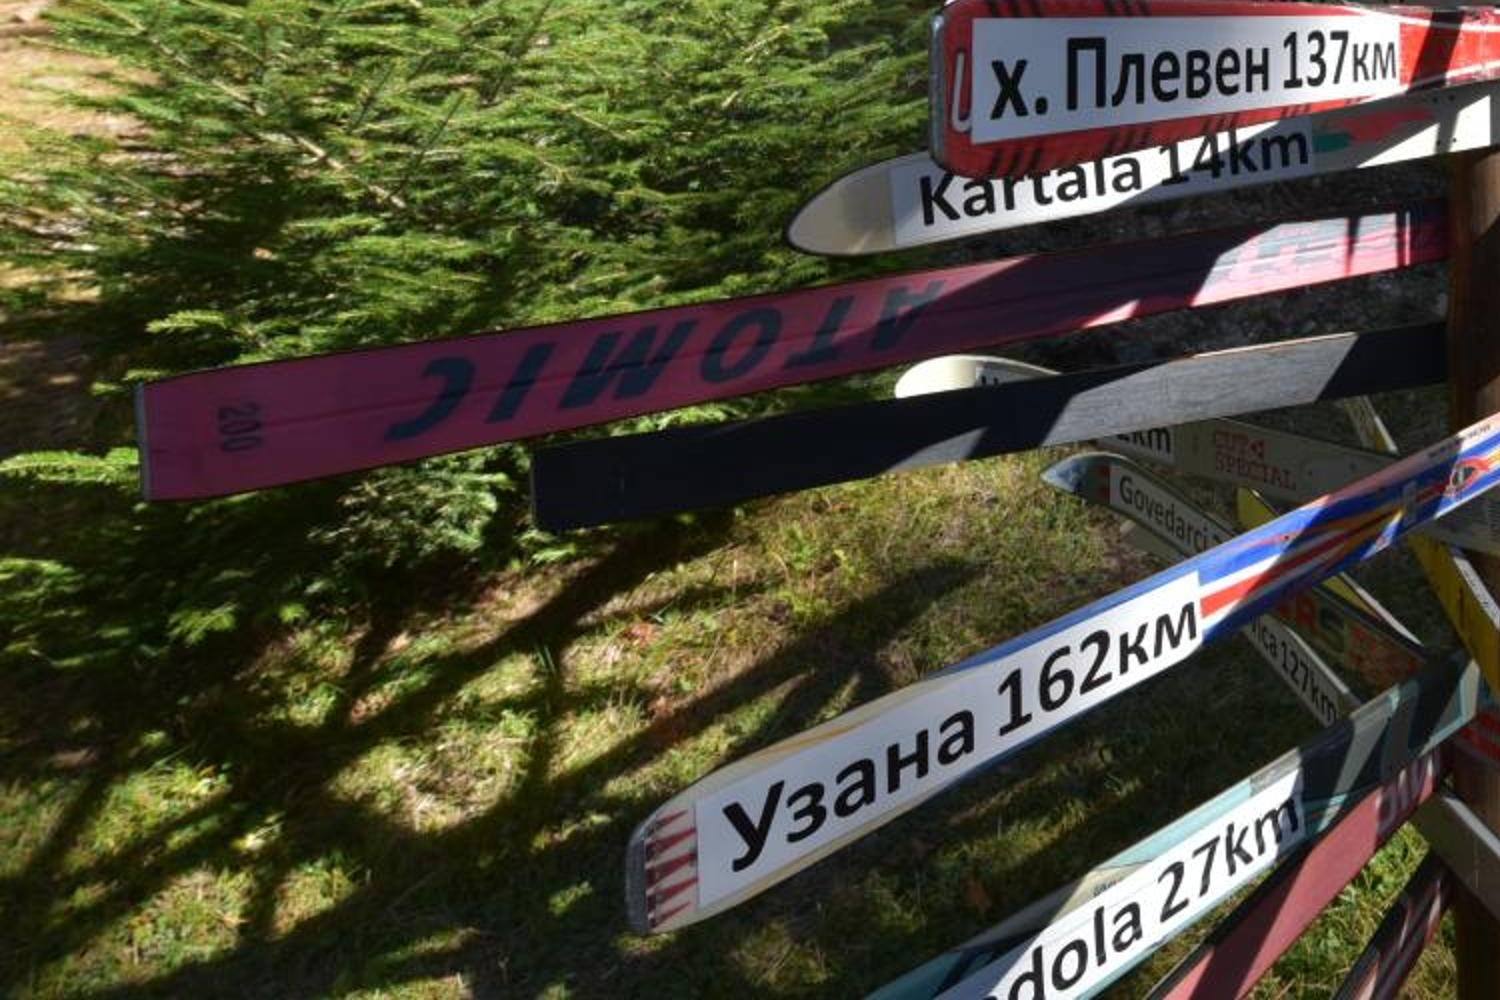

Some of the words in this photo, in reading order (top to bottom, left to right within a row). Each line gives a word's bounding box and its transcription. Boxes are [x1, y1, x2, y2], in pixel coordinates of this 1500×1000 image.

[989, 58, 1049, 121] х.
[1066, 36, 1271, 111] Плевен
[1283, 30, 1397, 88] 137км
[919, 155, 1142, 227] Kartala
[1160, 129, 1309, 187] 14km
[385, 277, 946, 442] ATOMIC
[723, 709, 977, 874] Узана
[997, 601, 1198, 737] 162км
[1280, 640, 1337, 724] 127km
[1006, 902, 1143, 1000] dola
[1158, 798, 1299, 924] 27km
